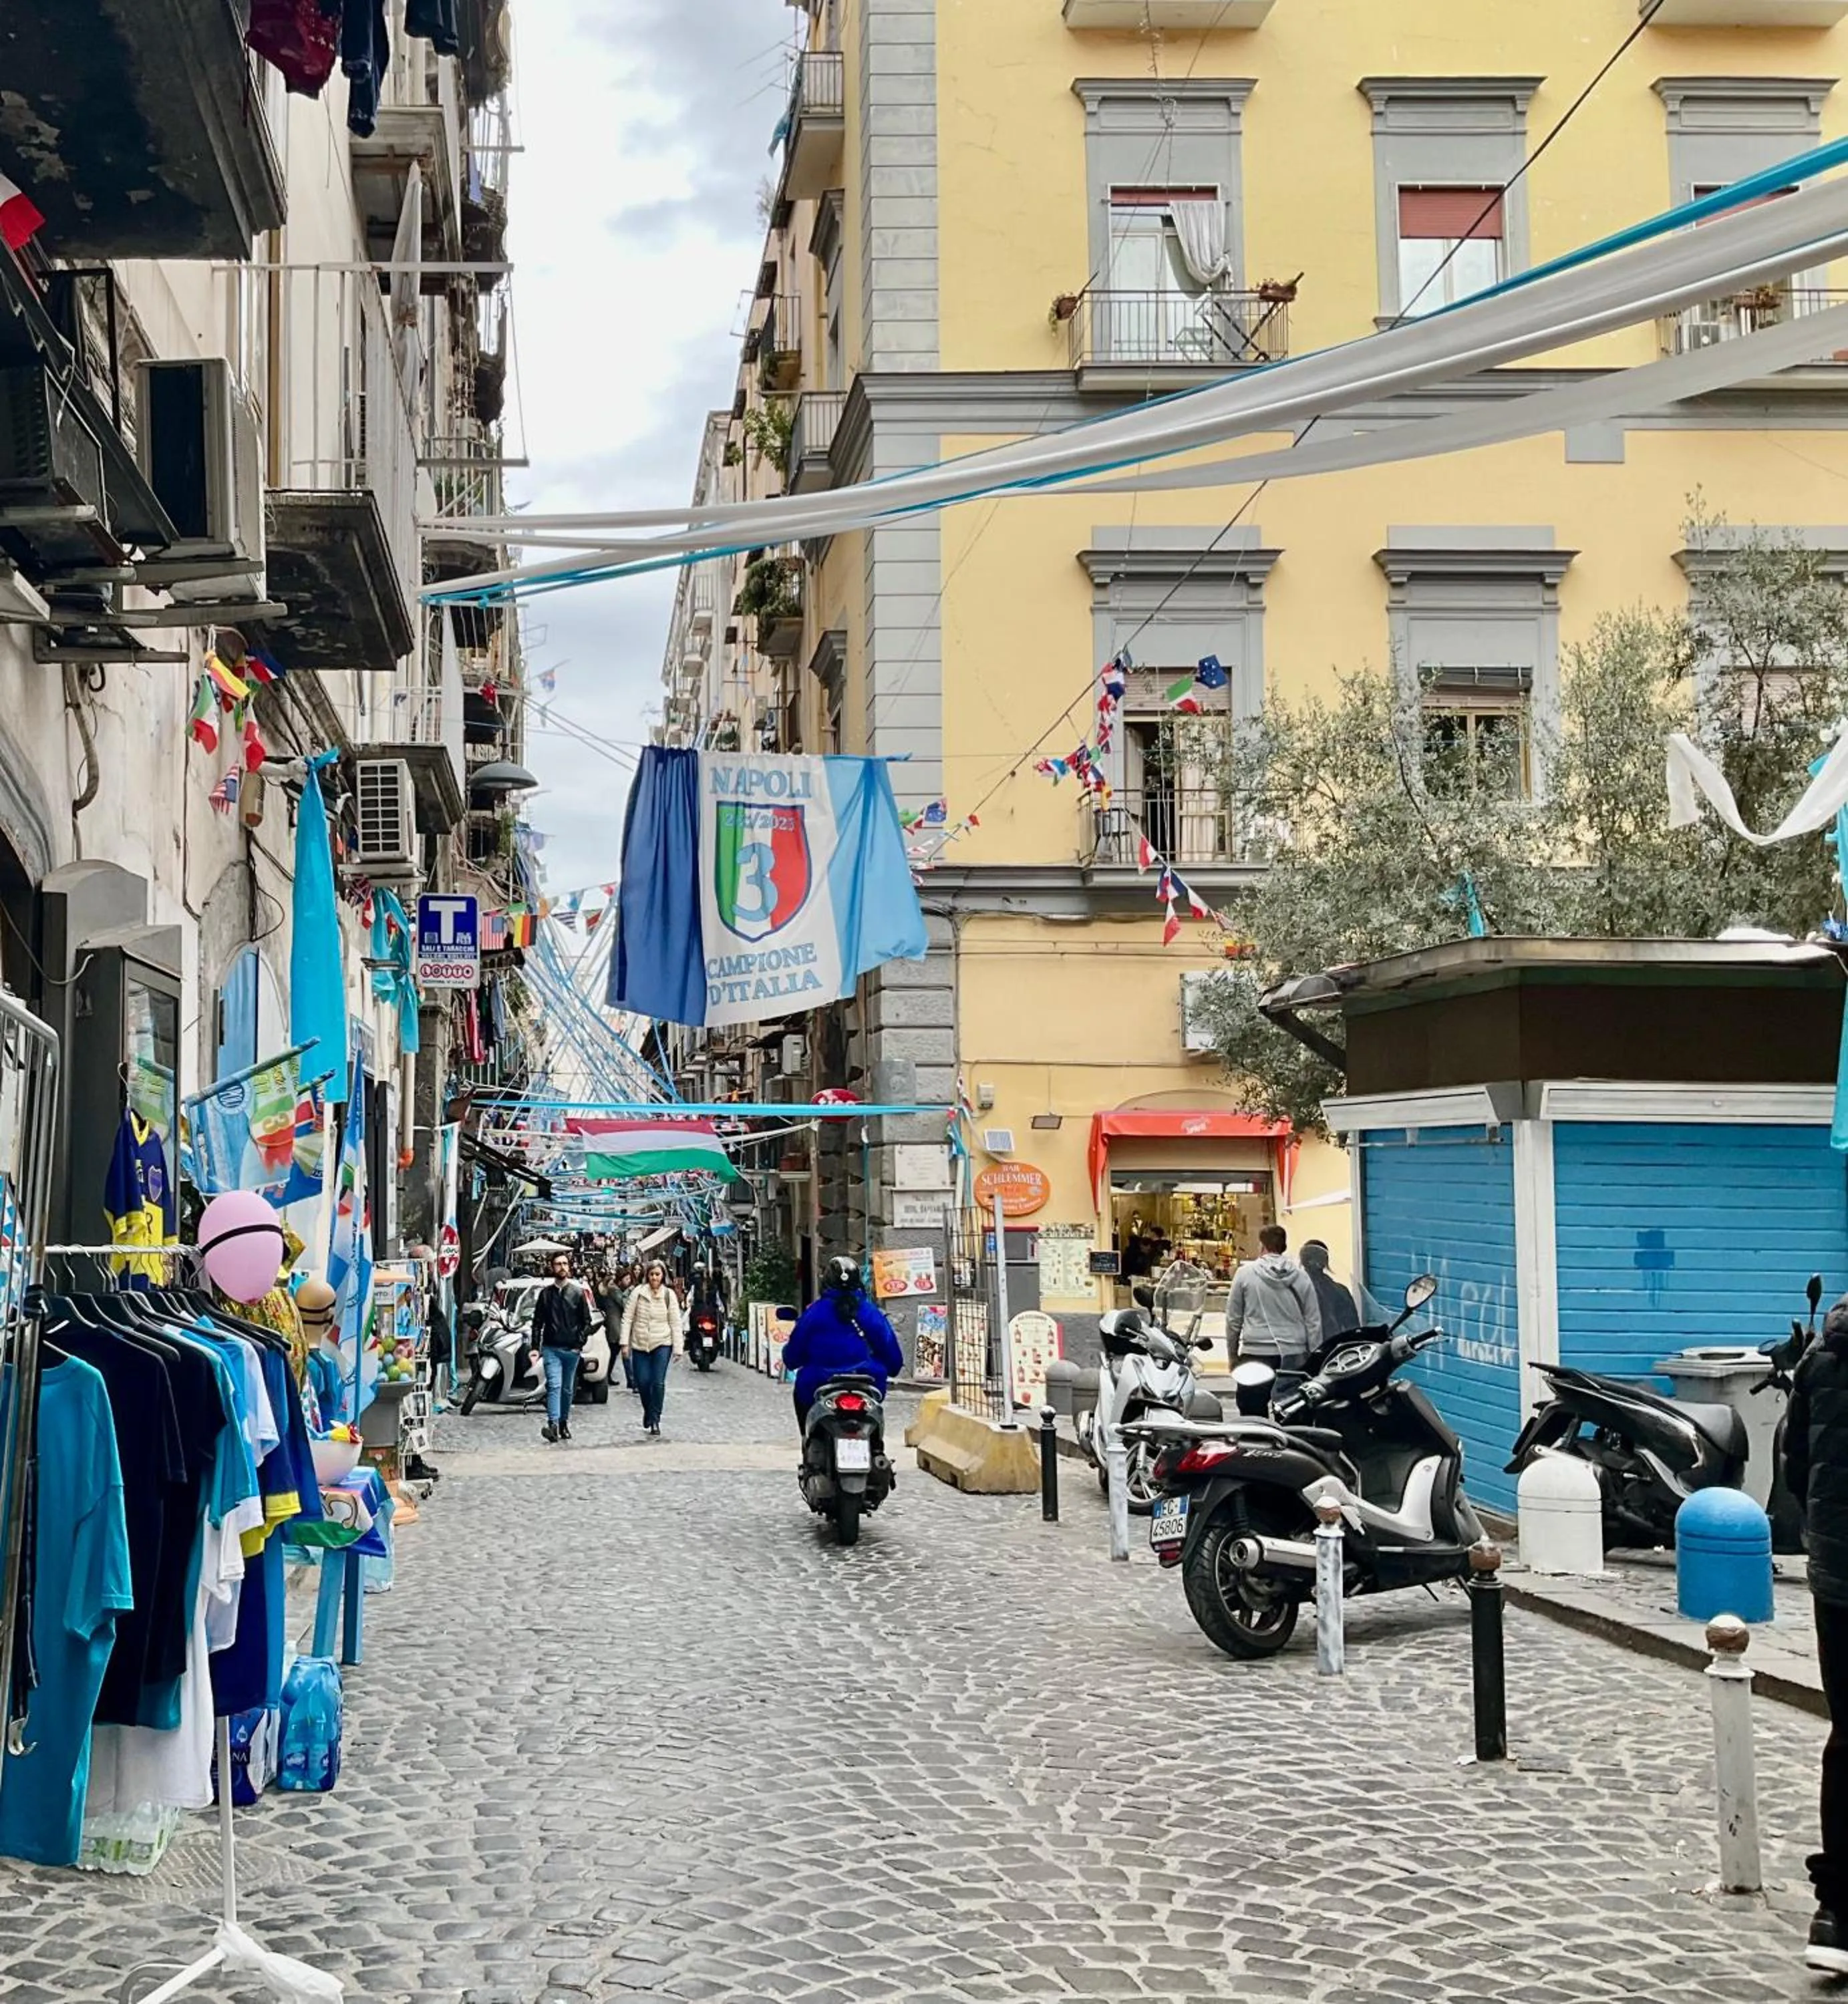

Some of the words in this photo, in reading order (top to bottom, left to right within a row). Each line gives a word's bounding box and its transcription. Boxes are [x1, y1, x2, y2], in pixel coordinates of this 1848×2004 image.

[710, 767, 812, 798] NAPOLI
[730, 842, 778, 923] 3
[428, 900, 467, 944] T
[420, 963, 473, 979] LOTTO
[706, 943, 818, 979] CAMPIONE
[708, 969, 823, 1005] D'ITALIA
[981, 1172, 1043, 1186] SCHLEMMER
[1153, 1517, 1183, 1537] 45806
